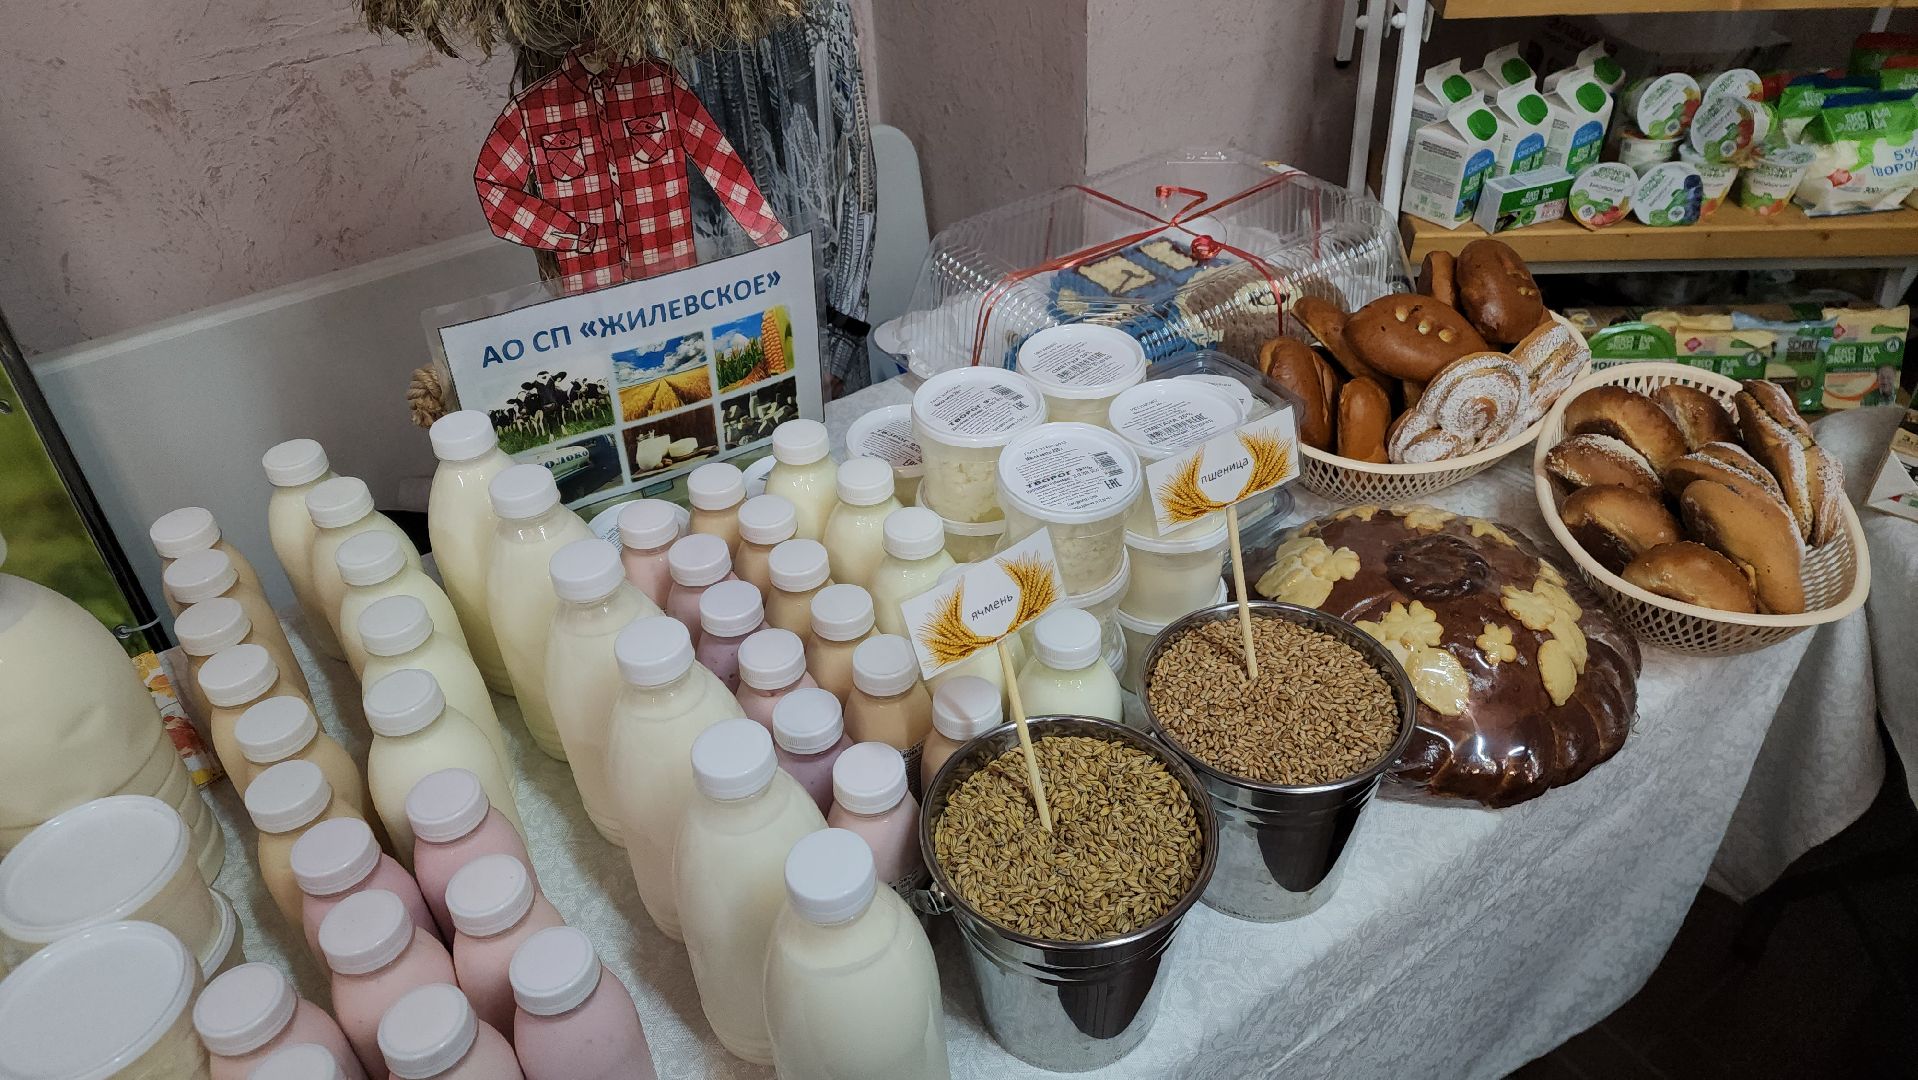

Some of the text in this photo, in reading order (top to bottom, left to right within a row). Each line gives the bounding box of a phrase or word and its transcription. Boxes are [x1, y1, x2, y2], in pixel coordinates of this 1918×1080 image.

[482, 270, 782, 368] АО СП «ЖИЛЕВСКОЕ»
[540, 451, 588, 469] ОЛОКО
[1200, 456, 1249, 484] пшеница
[1026, 470, 1071, 488] ТВОРОГ
[970, 593, 1013, 622] ячмень
